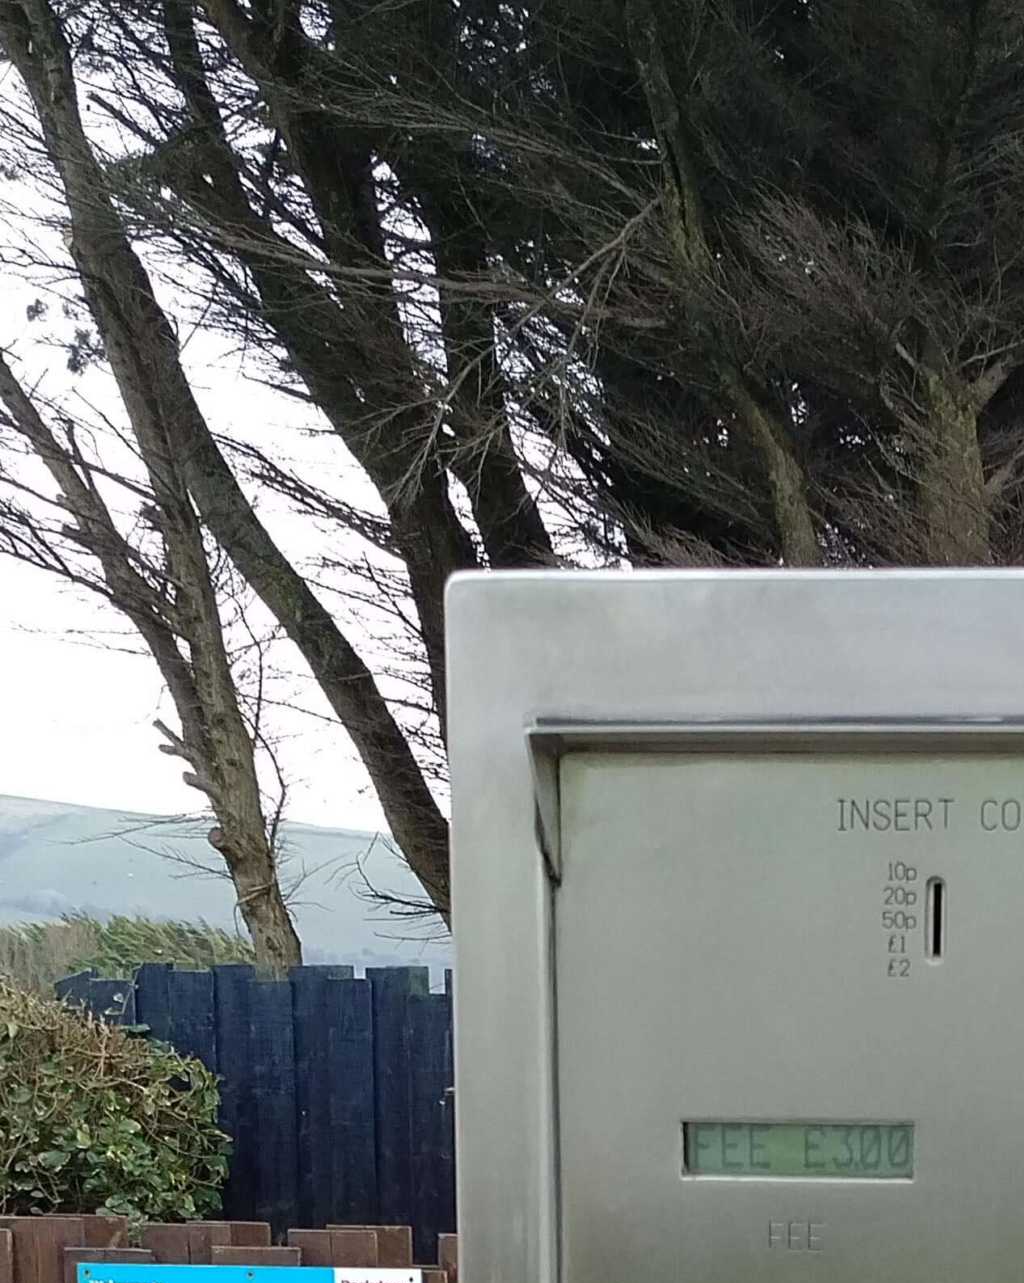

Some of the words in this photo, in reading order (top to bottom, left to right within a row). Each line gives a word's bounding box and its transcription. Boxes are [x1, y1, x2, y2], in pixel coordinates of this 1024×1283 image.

[837, 798, 954, 831] INSERT
[888, 861, 917, 882] 10p
[883, 886, 917, 906] 20p
[882, 910, 917, 930] 50p
[888, 935, 906, 954] £1
[887, 958, 911, 978] £2
[694, 1123, 770, 1169] FEE
[768, 1218, 824, 1252] FEE
